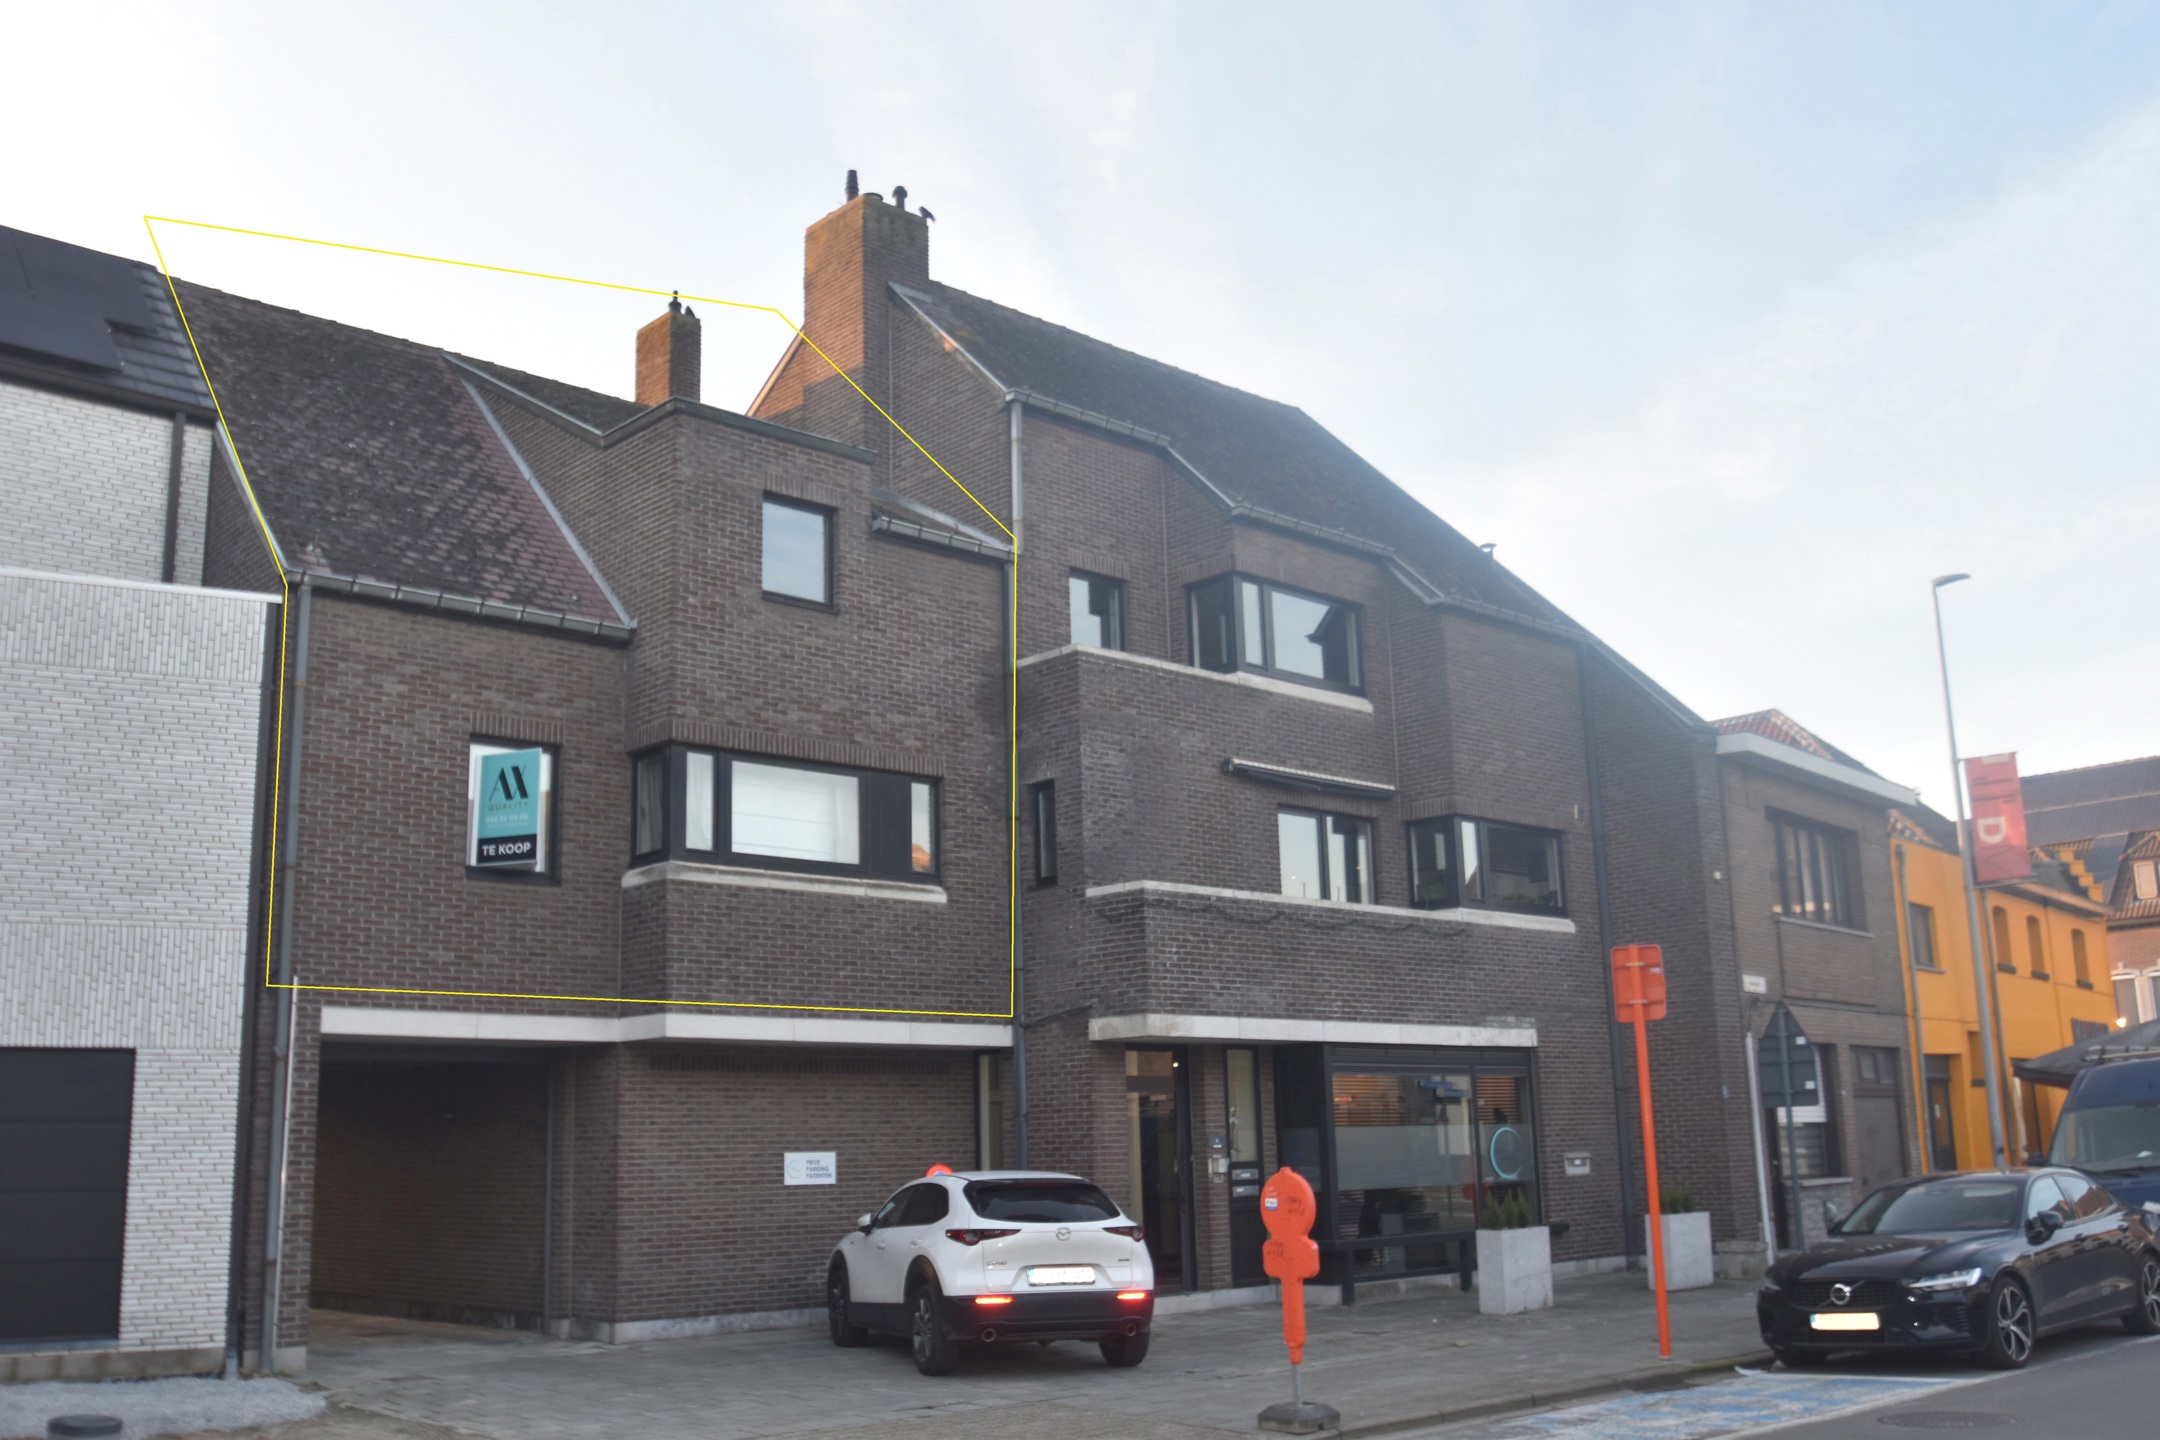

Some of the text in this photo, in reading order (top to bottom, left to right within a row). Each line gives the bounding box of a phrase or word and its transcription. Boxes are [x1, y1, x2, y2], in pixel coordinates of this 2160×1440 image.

[488, 801, 529, 812] QUALITY
[482, 841, 531, 856] TE KOOP
